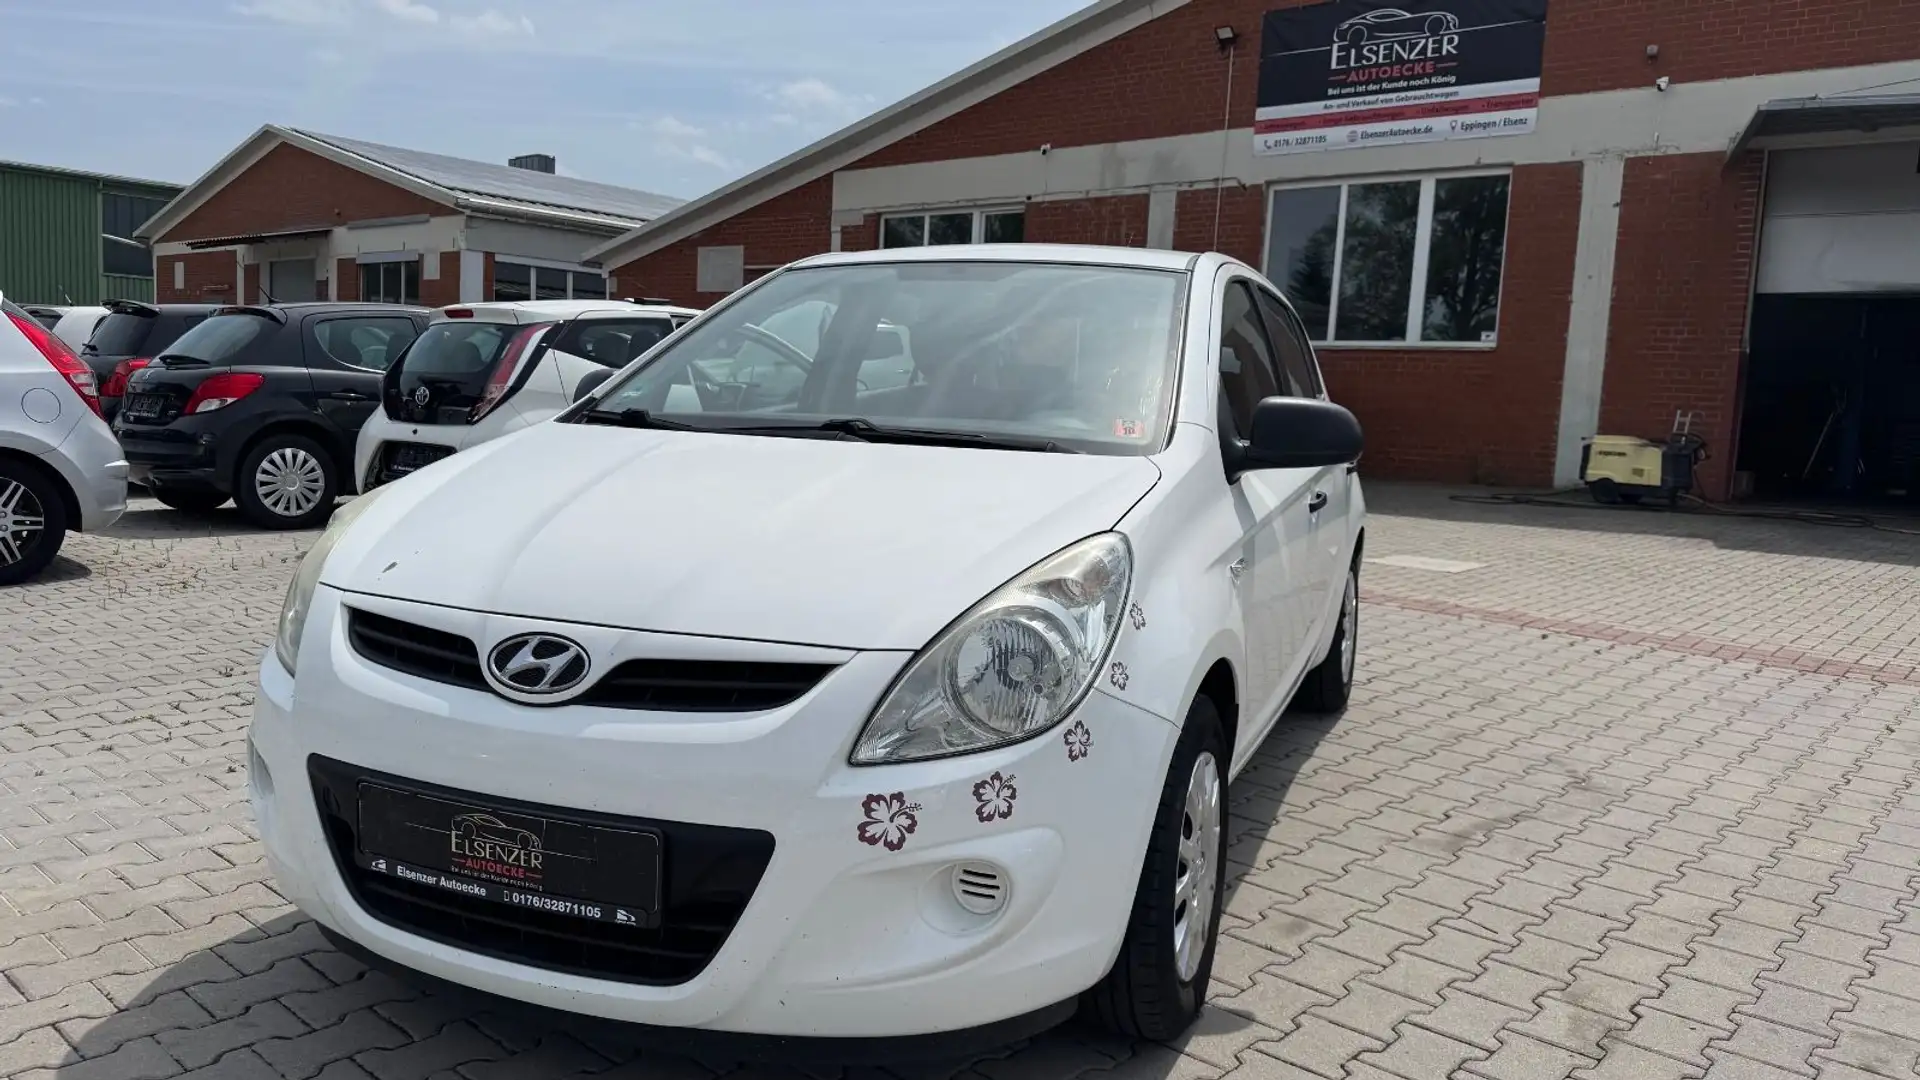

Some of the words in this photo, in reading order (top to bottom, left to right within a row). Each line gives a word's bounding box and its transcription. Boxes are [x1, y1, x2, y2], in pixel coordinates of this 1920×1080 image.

[1330, 34, 1460, 69] ELSENZER
[1346, 61, 1436, 83] AUTOECKE
[1327, 87, 1339, 96] Bei
[1341, 85, 1355, 94] uns
[1356, 84, 1366, 93] ist
[1367, 82, 1380, 91] der
[1381, 79, 1408, 90] Kunde
[1409, 77, 1430, 87] noch
[1431, 75, 1457, 85] König
[1351, 97, 1379, 108] Verkauf
[1380, 96, 1394, 105] von
[1395, 90, 1459, 103] Gebrauchtwagen
[1460, 119, 1497, 132] Eppingen
[1503, 116, 1528, 127] Elsenz
[451, 830, 543, 869] ELSENZER
[465, 857, 525, 879] AUTOECKE
[397, 865, 437, 885] Elsenzer
[440, 876, 487, 897] Autoecke
[512, 892, 602, 919] 0176/32871105
